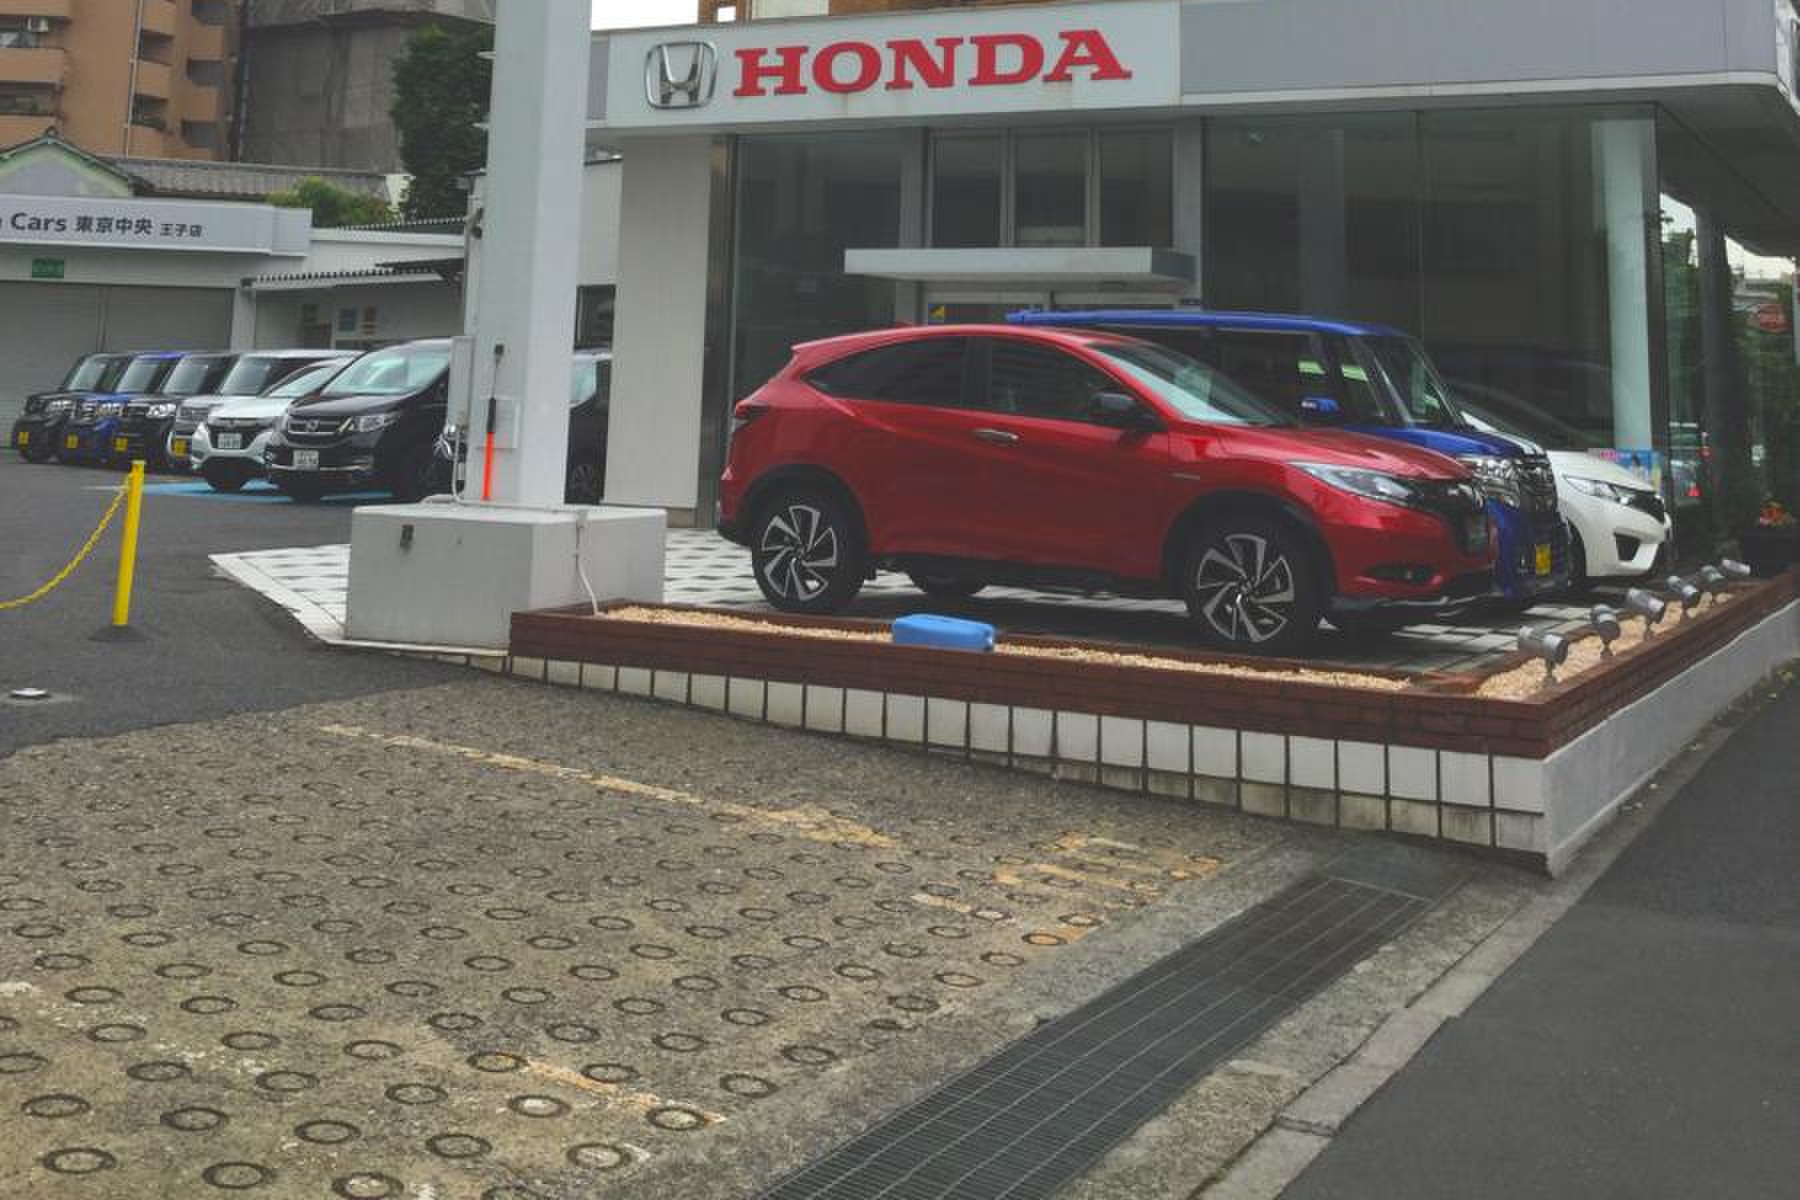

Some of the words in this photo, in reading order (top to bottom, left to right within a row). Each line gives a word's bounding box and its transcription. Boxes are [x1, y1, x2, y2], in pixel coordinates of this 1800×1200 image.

[733, 28, 1133, 98] HONDA
[10, 212, 67, 232] Cars
[75, 215, 153, 236] 東京中央
[160, 223, 204, 237] 王子店
